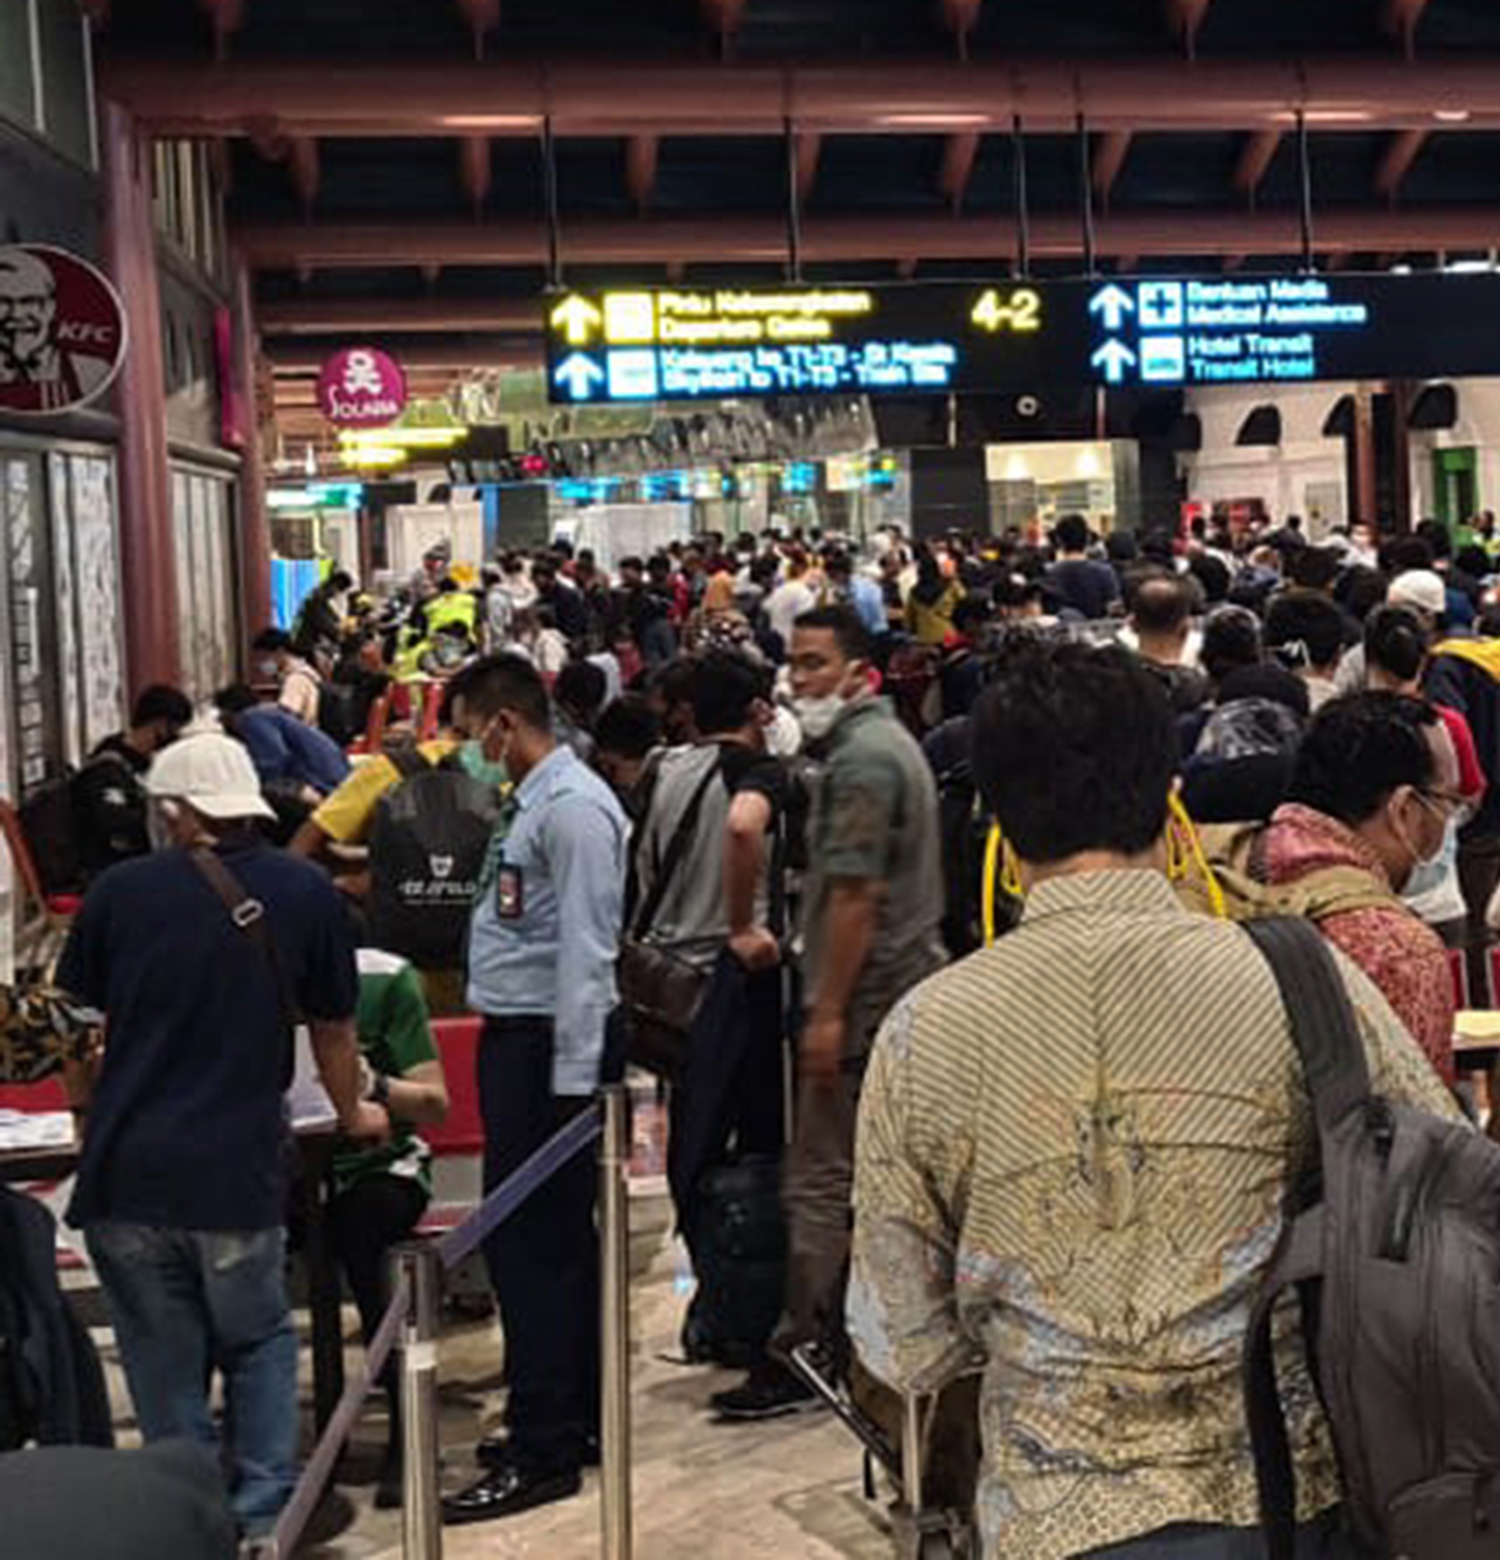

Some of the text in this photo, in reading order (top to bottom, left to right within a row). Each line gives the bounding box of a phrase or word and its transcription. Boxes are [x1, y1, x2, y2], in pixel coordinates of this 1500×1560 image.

[972, 289, 1039, 332] 4-2
[57, 320, 113, 343] KFC
[1189, 335, 1312, 355] Hotel Transit
[1191, 358, 1313, 377] Transit Hotel
